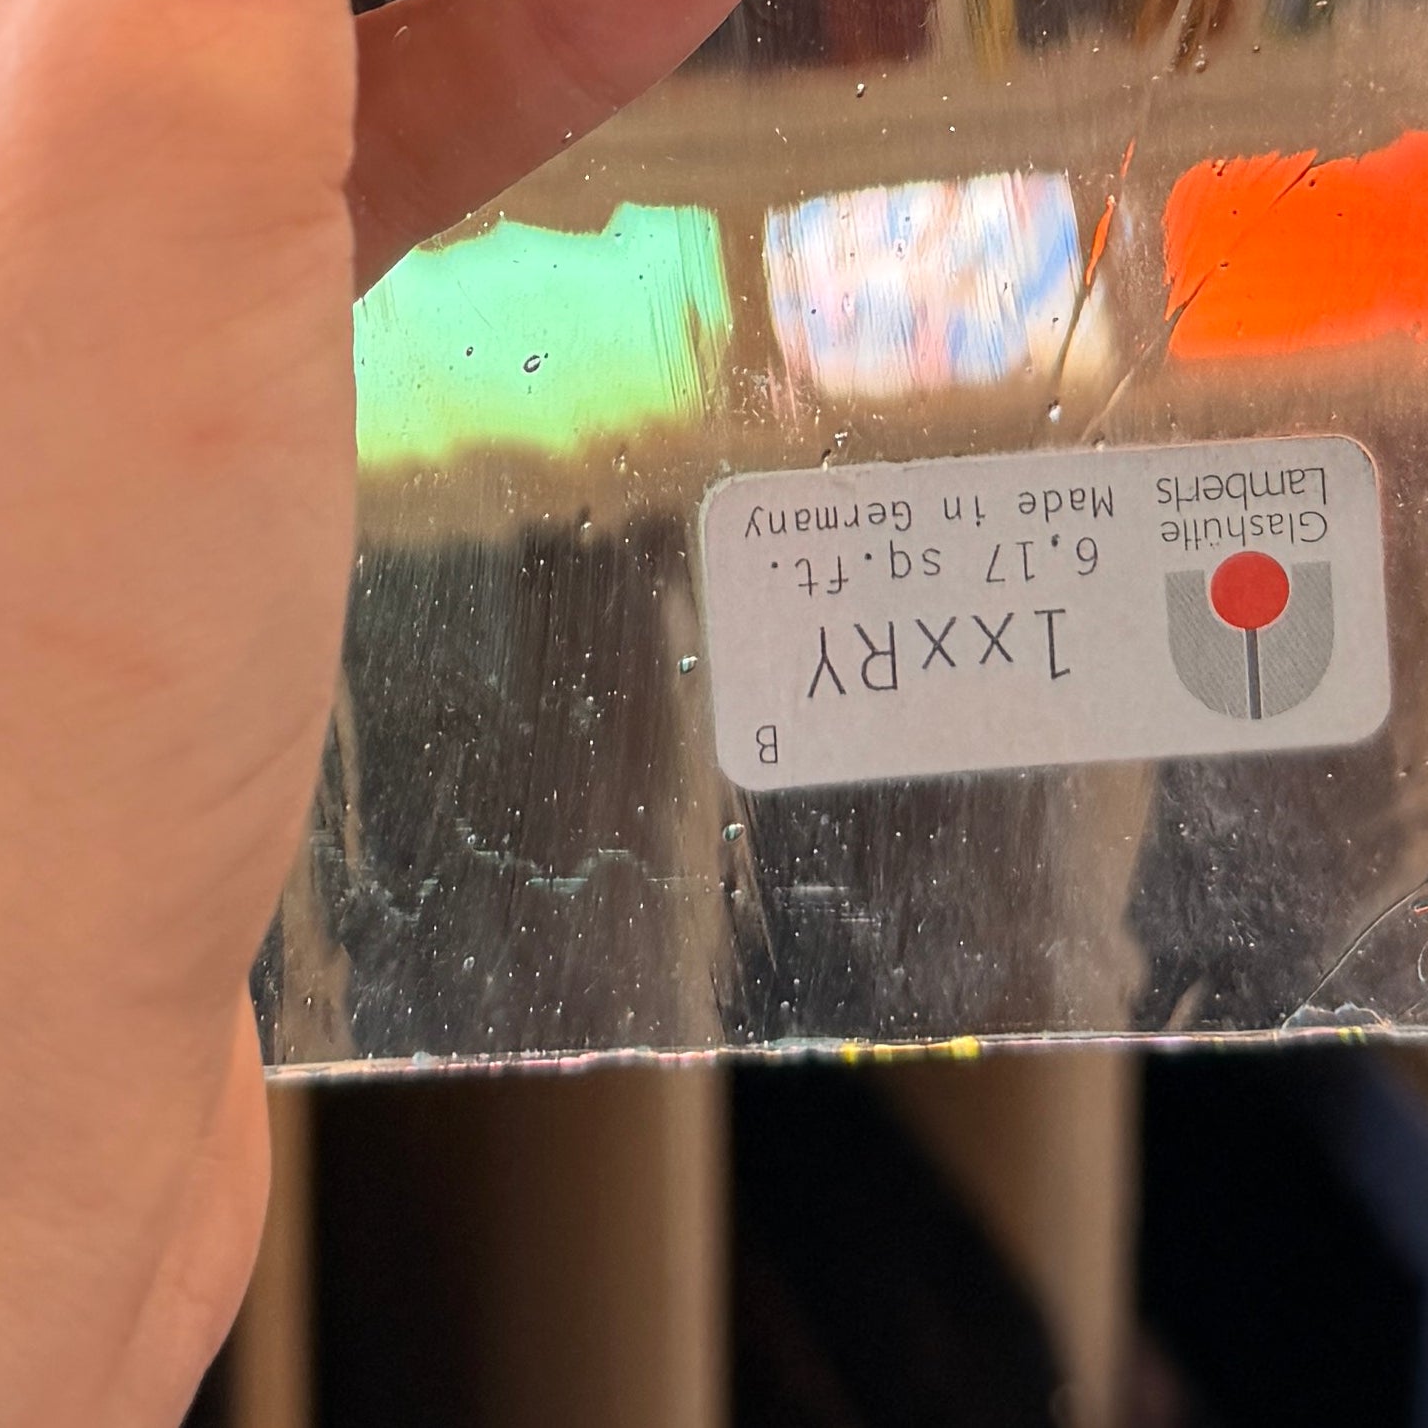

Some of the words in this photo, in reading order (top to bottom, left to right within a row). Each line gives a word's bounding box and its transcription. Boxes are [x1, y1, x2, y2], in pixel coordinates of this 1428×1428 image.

[1018, 485, 1115, 524] Made
[1156, 466, 1327, 513] Lamberts
[744, 499, 913, 539] Germany
[943, 495, 986, 527] in
[1160, 510, 1328, 551] Glashütte
[807, 608, 1071, 698] 1xxRY
[755, 724, 778, 764] B
